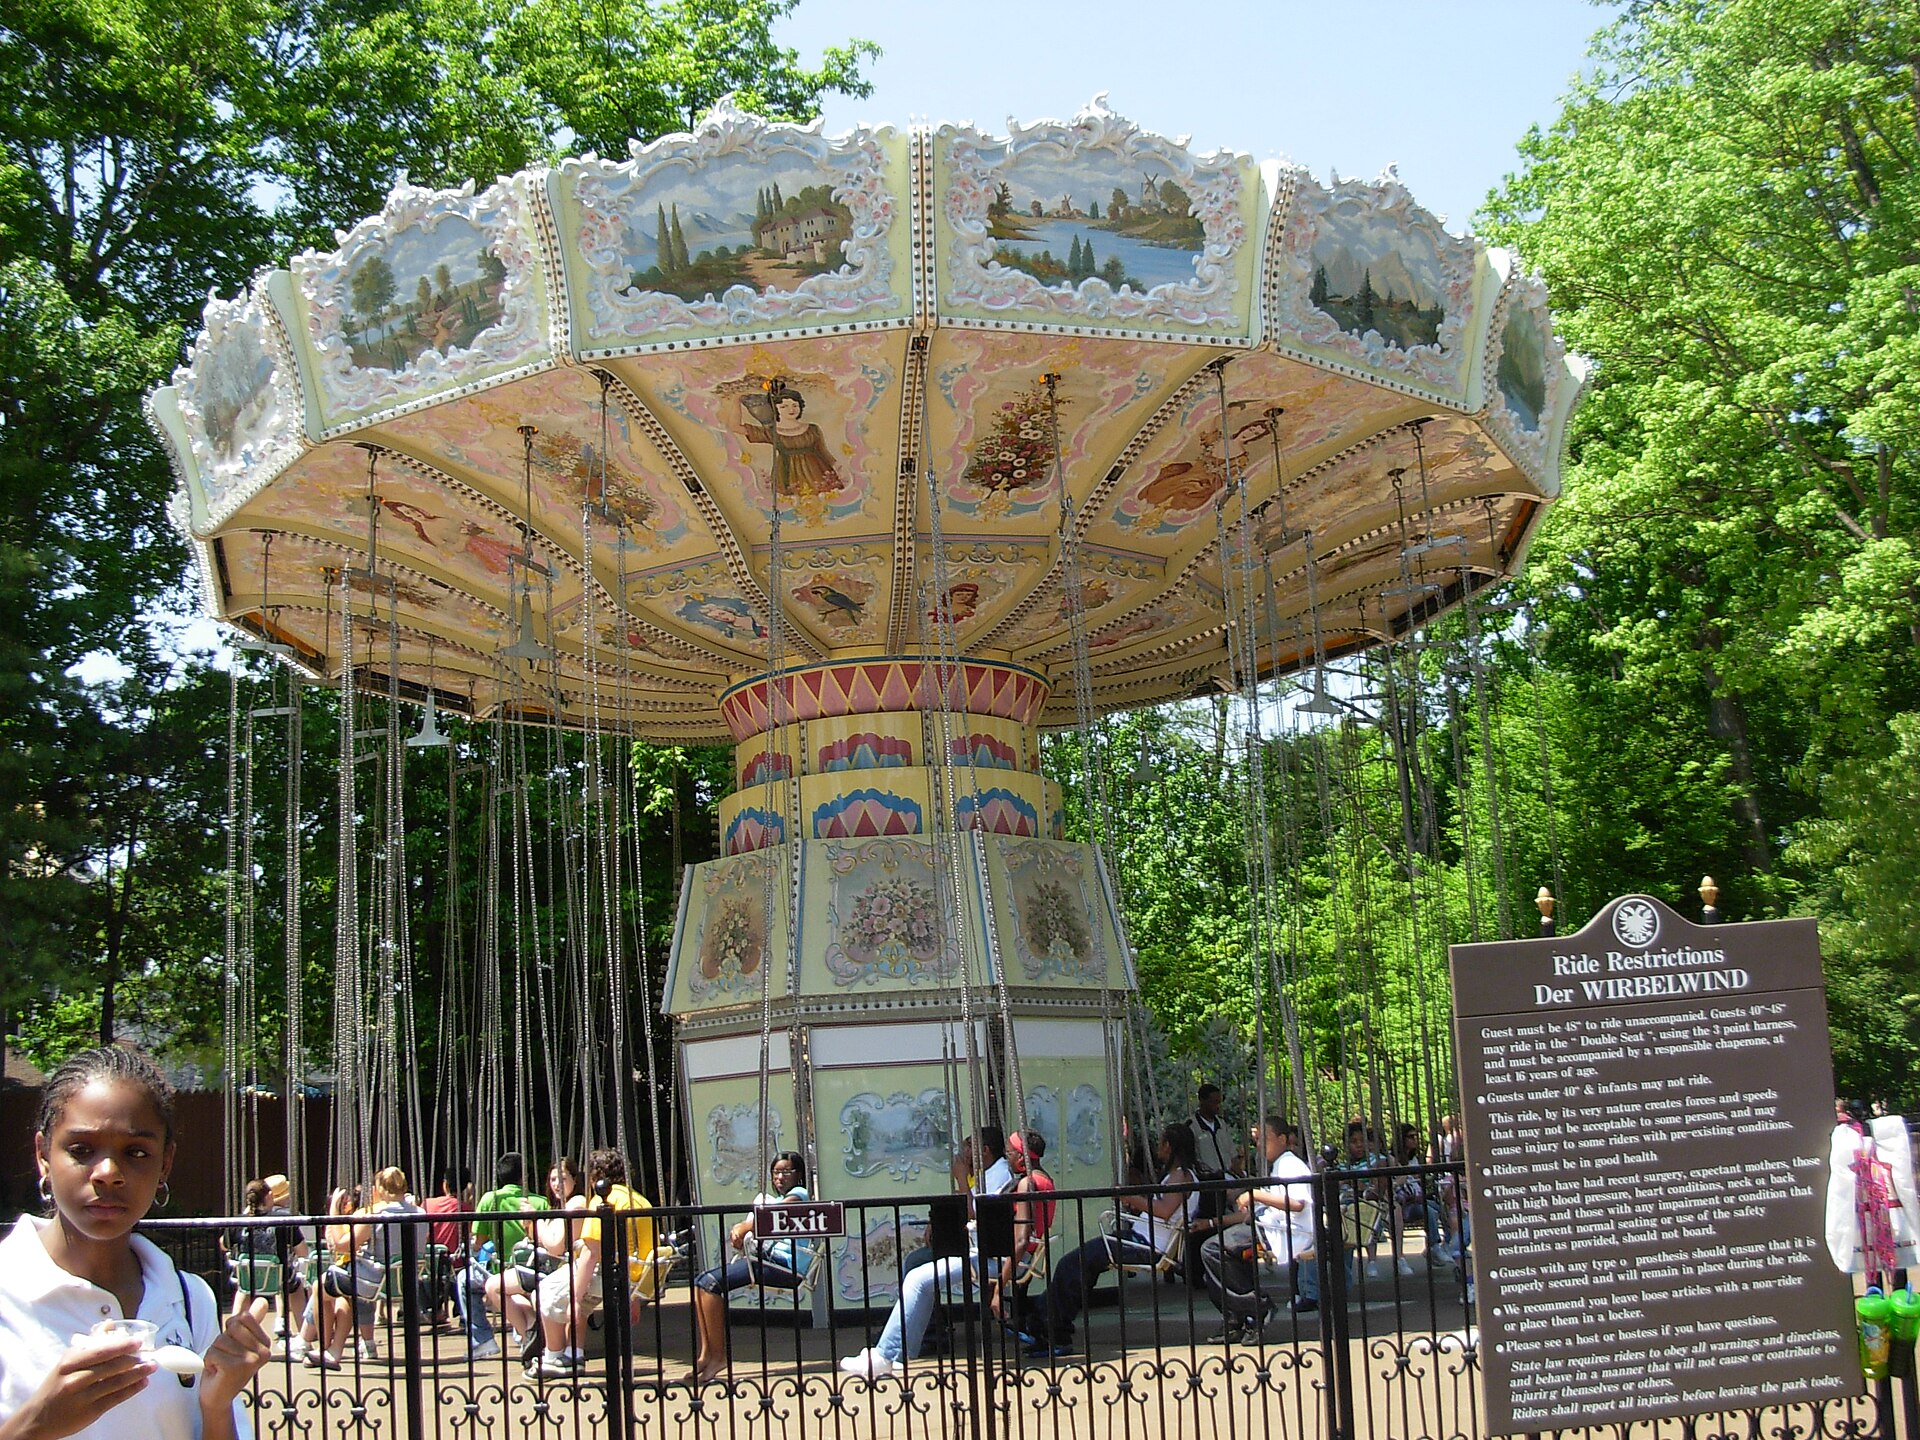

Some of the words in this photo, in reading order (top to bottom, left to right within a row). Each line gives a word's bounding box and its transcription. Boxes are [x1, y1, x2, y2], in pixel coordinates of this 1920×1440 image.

[1553, 954, 1600, 977] Ride
[1606, 946, 1725, 971] Restrictions
[1534, 985, 1574, 1005] Der
[1580, 969, 1748, 1000] WIRBELWIND
[1481, 1027, 1514, 1039] Guest
[1517, 1024, 1545, 1036] must
[1600, 1017, 1623, 1029] ride
[1710, 1008, 1747, 1019] Guests
[1510, 1041, 1532, 1053] ride
[1580, 1033, 1618, 1047] Double
[1620, 1032, 1645, 1043] Seat
[1659, 1028, 1690, 1040] using
[1723, 1022, 1751, 1036] point
[1509, 1056, 1537, 1067] must
[1556, 1047, 1624, 1063] accompanied
[1654, 1040, 1713, 1055] responsible
[1485, 1073, 1512, 1084] least
[1529, 1071, 1558, 1082] years
[1486, 1092, 1525, 1104] Guests
[1527, 1088, 1560, 1100] under
[1598, 1082, 1638, 1094] infants
[1488, 1112, 1514, 1124] This
[1562, 1107, 1577, 1118] its
[1579, 1107, 1602, 1117] very
[1606, 1103, 1642, 1114] nature
[1644, 1099, 1683, 1111] creates
[1685, 1096, 1717, 1107] forces
[1742, 1088, 1778, 1103] speeds
[1490, 1128, 1514, 1140] that
[1517, 1128, 1541, 1138] may
[1582, 1117, 1637, 1132] acceptable
[1654, 1115, 1682, 1125] some
[1754, 1106, 1777, 1117] may
[1491, 1146, 1522, 1156] cause
[1525, 1141, 1559, 1154] injury
[1578, 1138, 1606, 1148] some
[1608, 1134, 1640, 1146] riders
[1642, 1130, 1668, 1142] with
[1670, 1125, 1736, 1142] pre-existing
[1492, 1163, 1529, 1176] Riders
[1532, 1160, 1560, 1172] must
[1594, 1154, 1621, 1169] good
[1623, 1150, 1658, 1164] health
[1492, 1185, 1526, 1197] Those
[1529, 1181, 1552, 1193] who
[1555, 1180, 1580, 1191] have
[1583, 1176, 1605, 1188] had
[1607, 1173, 1641, 1186] recent
[1689, 1164, 1742, 1179] expectant
[1792, 1154, 1821, 1169] those
[1494, 1198, 1520, 1211] with
[1522, 1196, 1549, 1210] high
[1551, 1193, 1582, 1206] blood
[1634, 1186, 1665, 1198] heart
[1727, 1176, 1754, 1189] neck
[1770, 1171, 1797, 1184] back
[1574, 1207, 1604, 1219] those
[1607, 1203, 1633, 1215] with
[1634, 1203, 1655, 1214] any
[1658, 1196, 1721, 1211] impairment
[1738, 1188, 1789, 1202] condition
[1790, 1185, 1812, 1197] that
[770, 1209, 828, 1233] Exit
[1497, 1227, 1530, 1241] would
[1533, 1225, 1573, 1240] prevent
[1576, 1219, 1616, 1233] normal
[1618, 1216, 1658, 1229] seating
[1675, 1214, 1695, 1224] use
[1733, 1205, 1766, 1218] safety
[1498, 1242, 1552, 1256] restraints
[1622, 1230, 1658, 1244] should
[1661, 1229, 1680, 1240] not
[1498, 1266, 1537, 1279] Guests
[1540, 1262, 1566, 1274] with
[1568, 1262, 1588, 1273] any
[1592, 1259, 1617, 1271] type
[1635, 1250, 1690, 1267] prosthesis
[1691, 1245, 1728, 1259] should
[1730, 1244, 1766, 1255] ensure
[1768, 1239, 1793, 1251] that
[1500, 1279, 1544, 1296] properly
[1548, 1274, 1590, 1289] secured
[1592, 1271, 1614, 1284] and
[1617, 1269, 1639, 1281] will
[1641, 1265, 1680, 1279] remain
[1697, 1262, 1726, 1276] place
[1726, 1257, 1765, 1270] during
[1766, 1254, 1785, 1266] the
[1523, 1297, 1586, 1314] recommend
[1588, 1297, 1609, 1309] you
[1611, 1293, 1639, 1305] leave
[1641, 1290, 1669, 1302] loose
[1672, 1284, 1712, 1298] articles
[1714, 1281, 1740, 1293] with
[1752, 1275, 1804, 1289] non-rider
[1506, 1340, 1542, 1353] Please
[1544, 1339, 1562, 1348] see
[1576, 1333, 1600, 1345] host
[1618, 1328, 1659, 1341] hostess
[1674, 1325, 1695, 1337] you
[1696, 1321, 1722, 1332] have
[1520, 1318, 1548, 1332] place
[1551, 1315, 1580, 1327] them
[1509, 1375, 1532, 1388] and
[1535, 1372, 1574, 1386] behave
[1602, 1366, 1645, 1378] manner
[1647, 1361, 1671, 1374] that
[1674, 1357, 1696, 1370] will
[1698, 1357, 1717, 1369] not
[1719, 1355, 1750, 1366] cause
[1766, 1346, 1822, 1361] contribute
[1510, 1360, 1542, 1373] State
[1544, 1358, 1564, 1370] law
[1567, 1353, 1611, 1368] requires
[1614, 1350, 1646, 1362] riders
[1663, 1345, 1689, 1357] obey
[1691, 1341, 1708, 1355] all
[1710, 1338, 1761, 1352] warnings
[1762, 1333, 1785, 1346] and
[1512, 1407, 1549, 1421] Riders
[1550, 1402, 1580, 1416] shall
[1582, 1399, 1617, 1414] report
[1618, 1396, 1635, 1410] all
[1636, 1392, 1680, 1408] injuries
[1682, 1389, 1717, 1402] before
[1718, 1384, 1760, 1399] leaving
[1761, 1381, 1780, 1394] the
[1781, 1377, 1808, 1393] park
[1561, 1382, 1620, 1398] themselves
